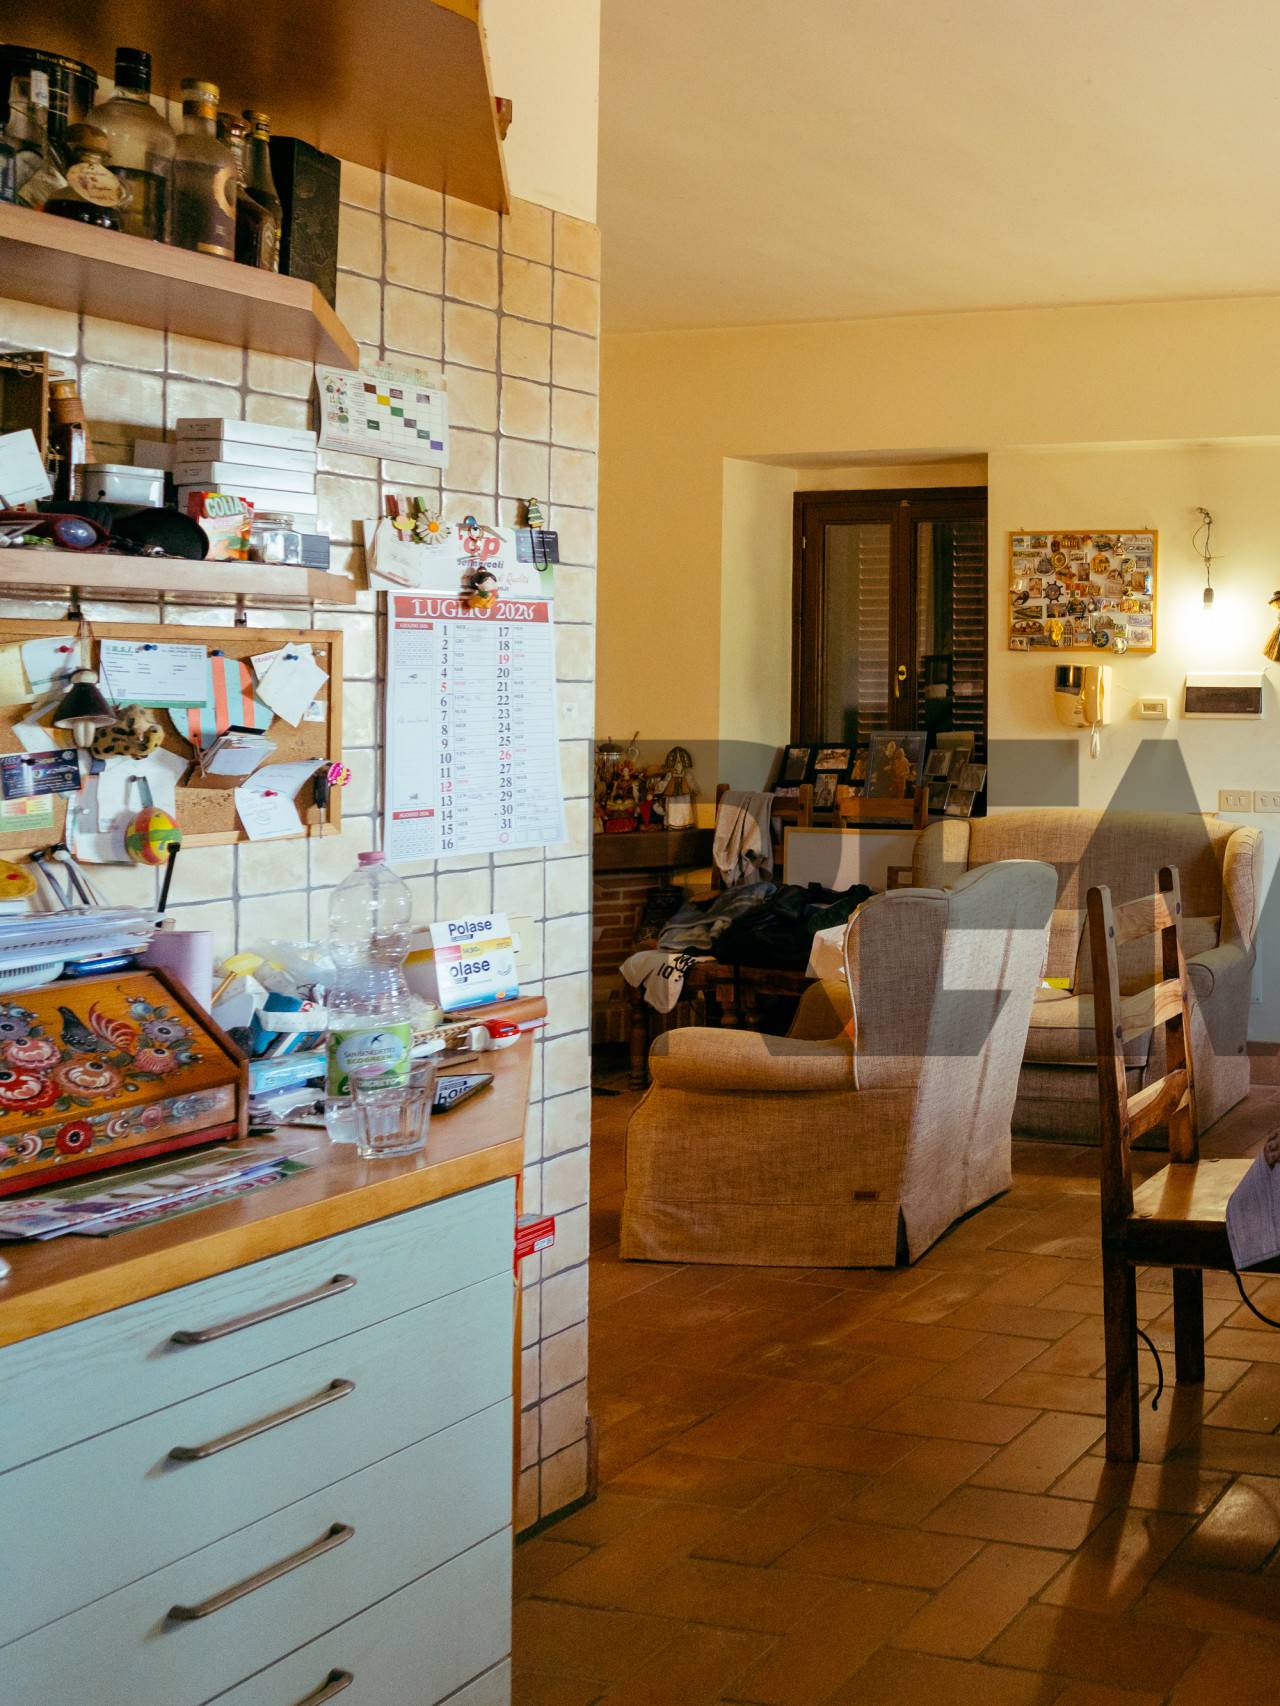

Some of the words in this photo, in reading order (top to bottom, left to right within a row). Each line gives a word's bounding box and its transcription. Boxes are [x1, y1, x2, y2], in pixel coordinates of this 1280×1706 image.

[443, 625, 447, 636] 1
[498, 627, 509, 637] 17
[442, 640, 448, 650] 2
[498, 641, 510, 651] 18
[441, 654, 447, 664] 3
[498, 654, 509, 665] 19
[441, 668, 447, 678] 4
[497, 668, 509, 678] 20
[440, 682, 447, 693] 5
[497, 681, 508, 692] 21
[440, 697, 447, 707] 6
[497, 695, 509, 705] 22
[442, 711, 447, 721] 7
[498, 709, 510, 719] 23
[441, 725, 448, 735] 8
[498, 723, 510, 733] 24
[441, 739, 448, 749] 9
[499, 737, 511, 747] 25
[440, 753, 452, 764] 10
[499, 750, 511, 761] 26
[440, 768, 451, 778] 11
[499, 764, 511, 774] 27
[441, 782, 452, 792] 12
[500, 777, 512, 788] 28
[500, 791, 512, 801] 29
[441, 796, 452, 807] 13
[500, 805, 513, 815] 30
[442, 811, 453, 821] 14
[501, 819, 512, 829] 31
[441, 825, 453, 835] 15
[441, 839, 453, 849] 16
[448, 920, 493, 936] Polase
